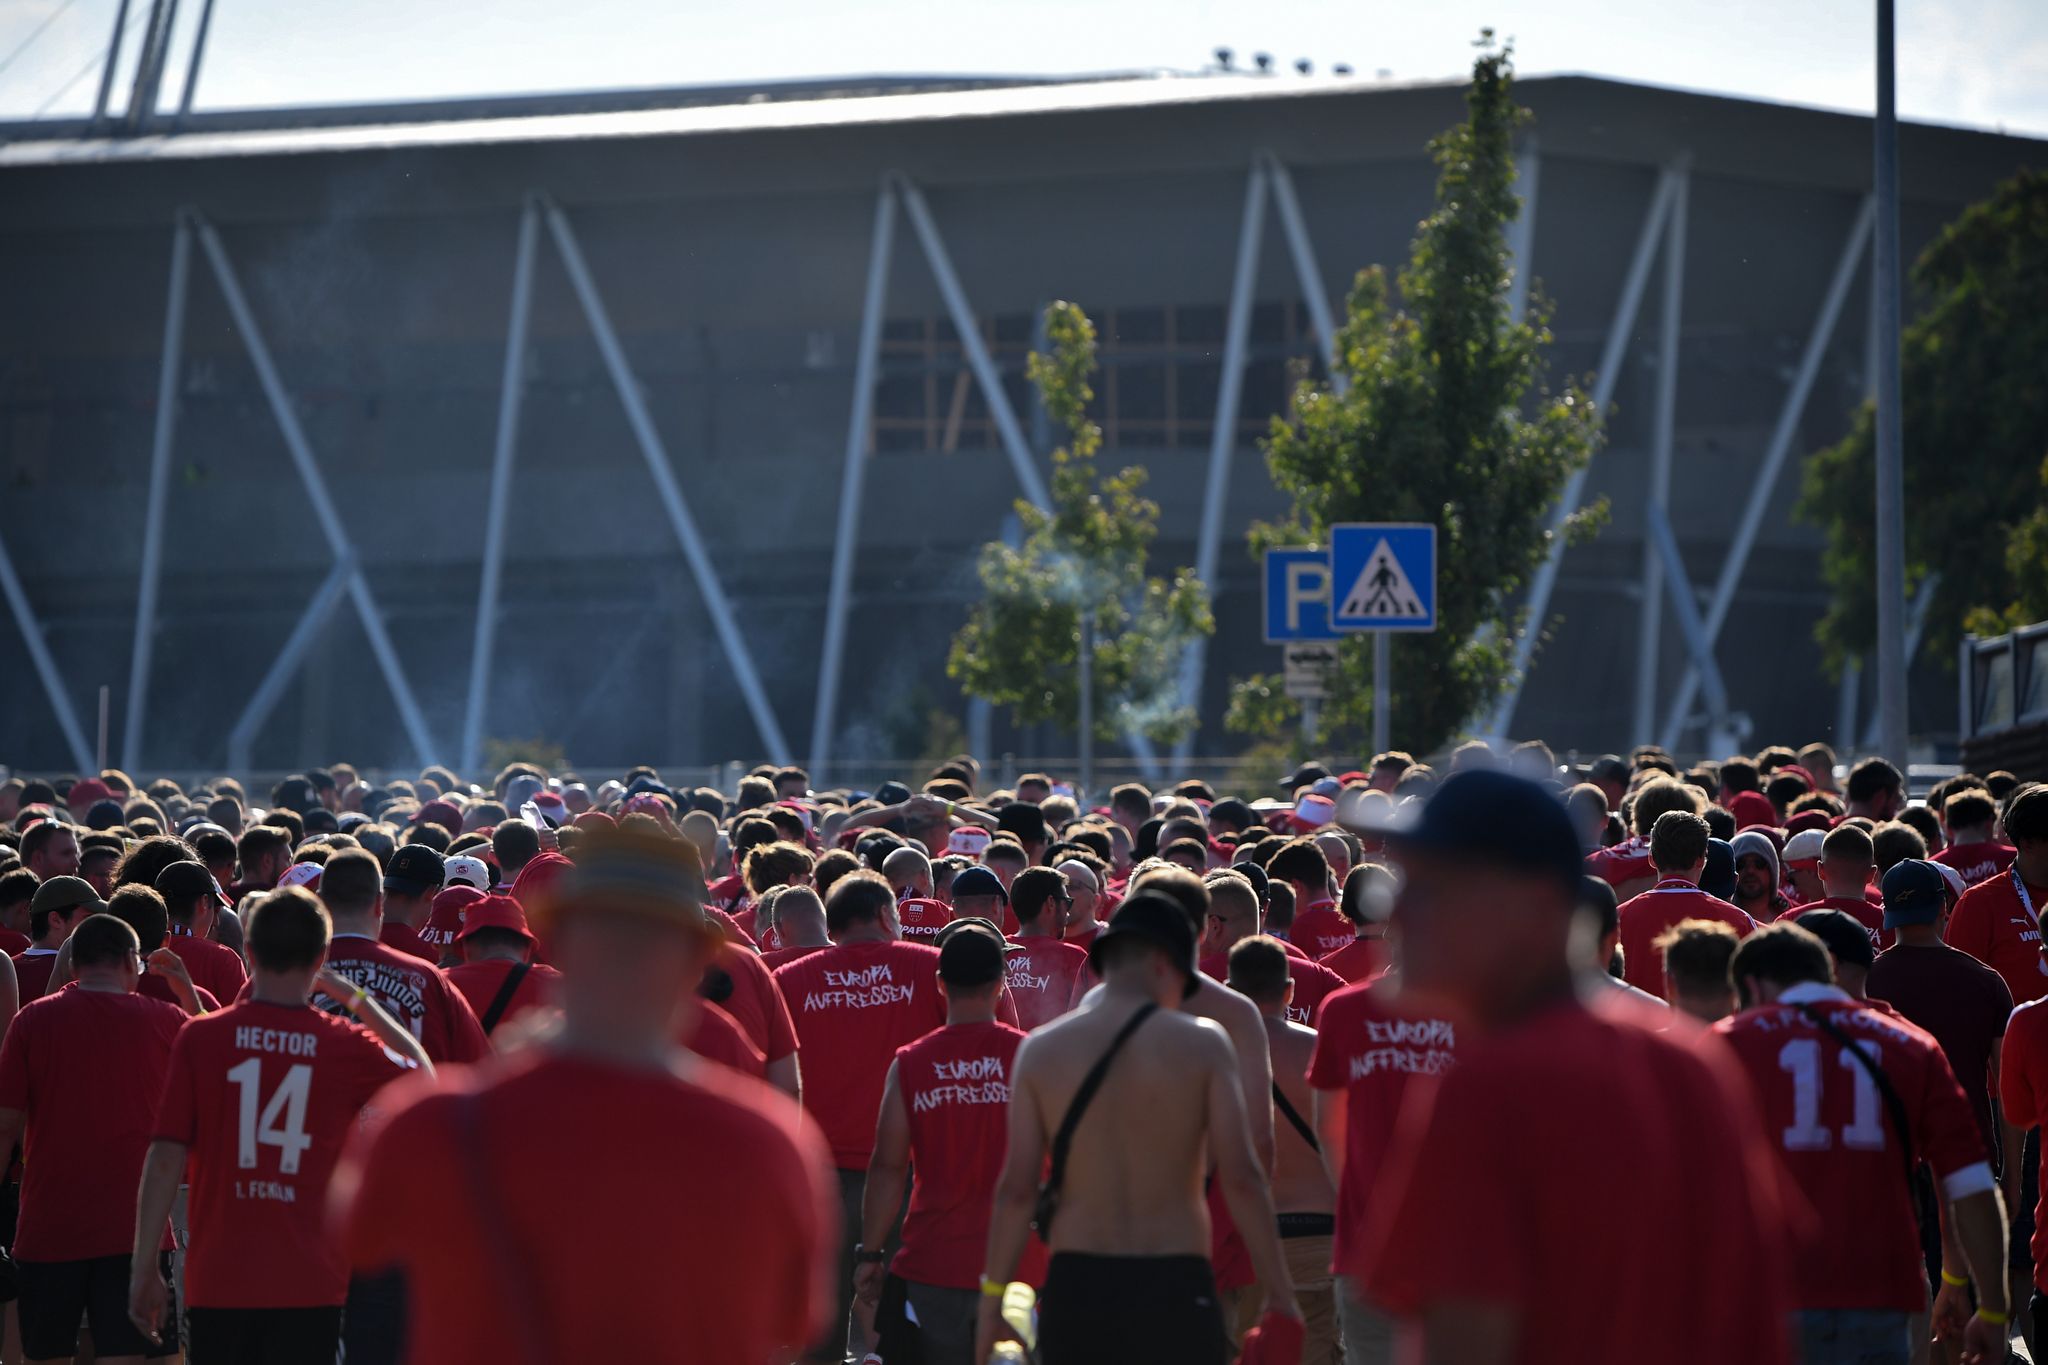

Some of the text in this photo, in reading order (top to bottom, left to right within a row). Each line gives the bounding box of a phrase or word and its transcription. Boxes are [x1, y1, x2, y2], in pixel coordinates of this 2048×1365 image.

[1285, 561, 1331, 631] P
[823, 963, 892, 987] EUROPA
[803, 977, 914, 1014] AUFFRESSEN
[235, 1025, 318, 1057] HECTOR
[1364, 1018, 1455, 1049] EUROPA
[932, 1055, 1004, 1080] EUROPA
[913, 1080, 1012, 1113] AUFFRESSE
[1778, 1038, 1886, 1150] 11
[227, 1056, 313, 1175] 14
